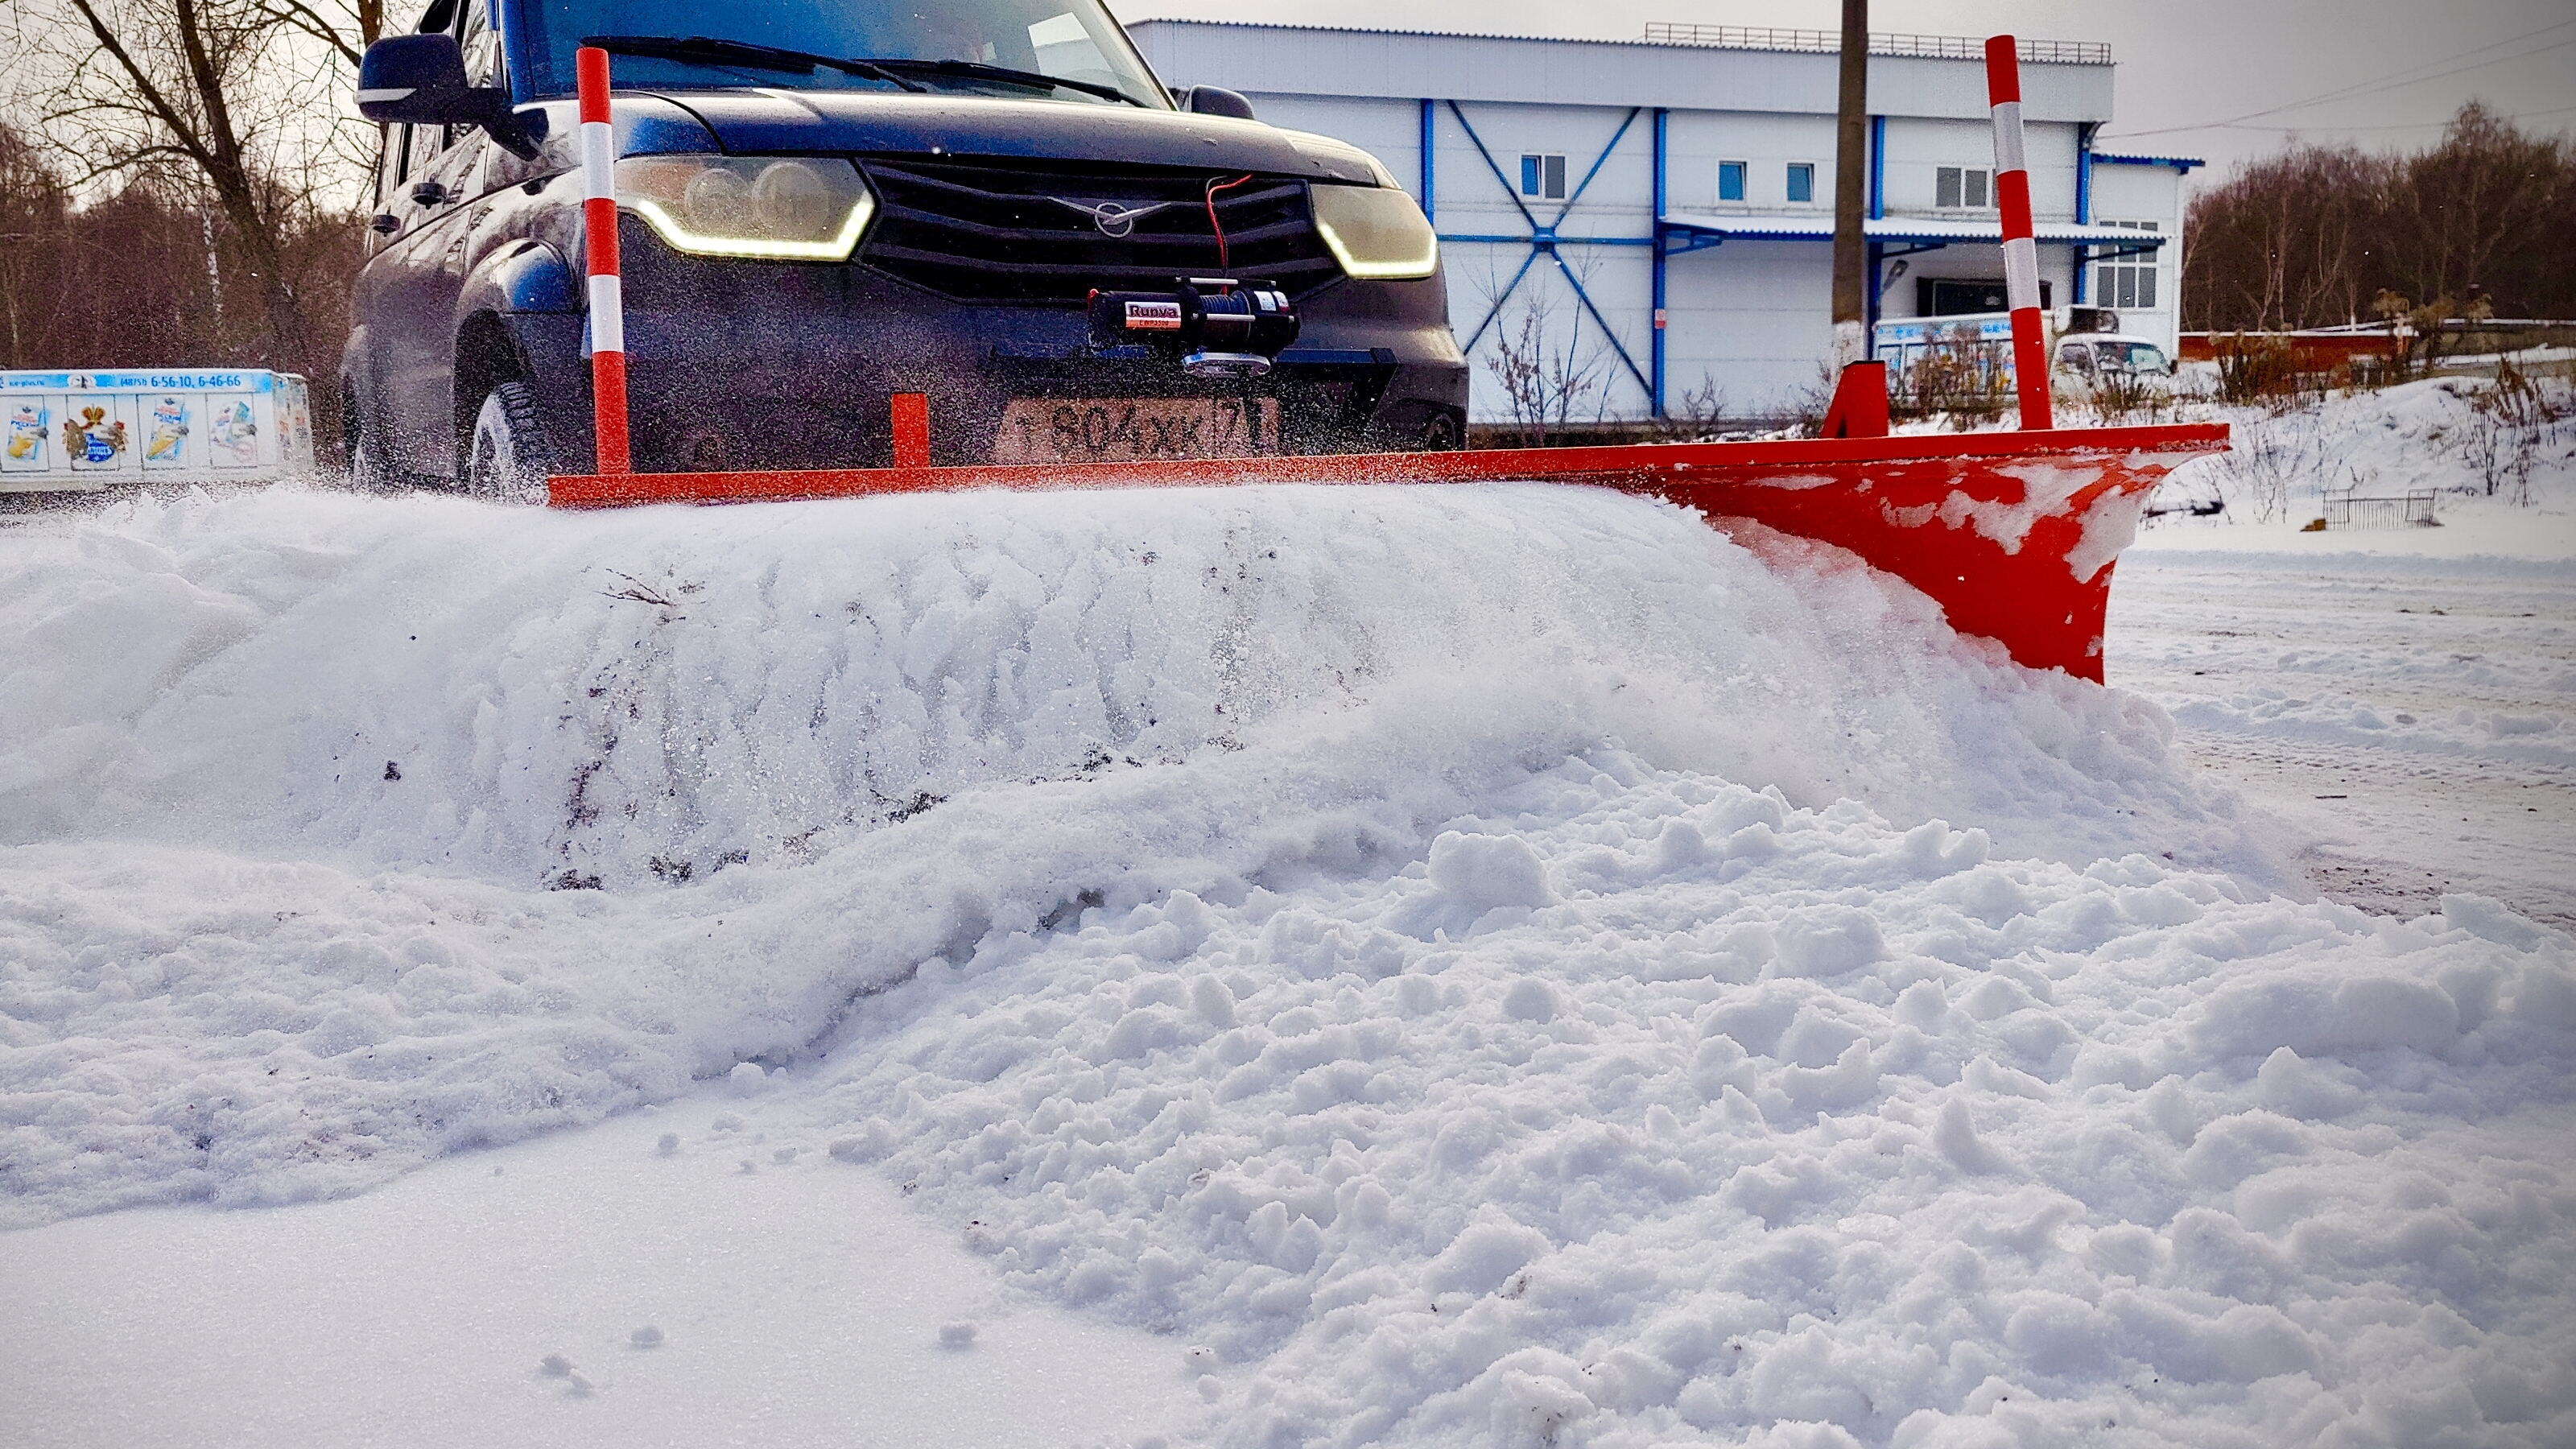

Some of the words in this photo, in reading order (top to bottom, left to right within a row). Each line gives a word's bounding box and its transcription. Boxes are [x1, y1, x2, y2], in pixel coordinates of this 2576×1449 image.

[1129, 305, 1178, 318] Runva
[151, 375, 195, 388] 6-56-10,
[198, 375, 242, 386] 6-46-66
